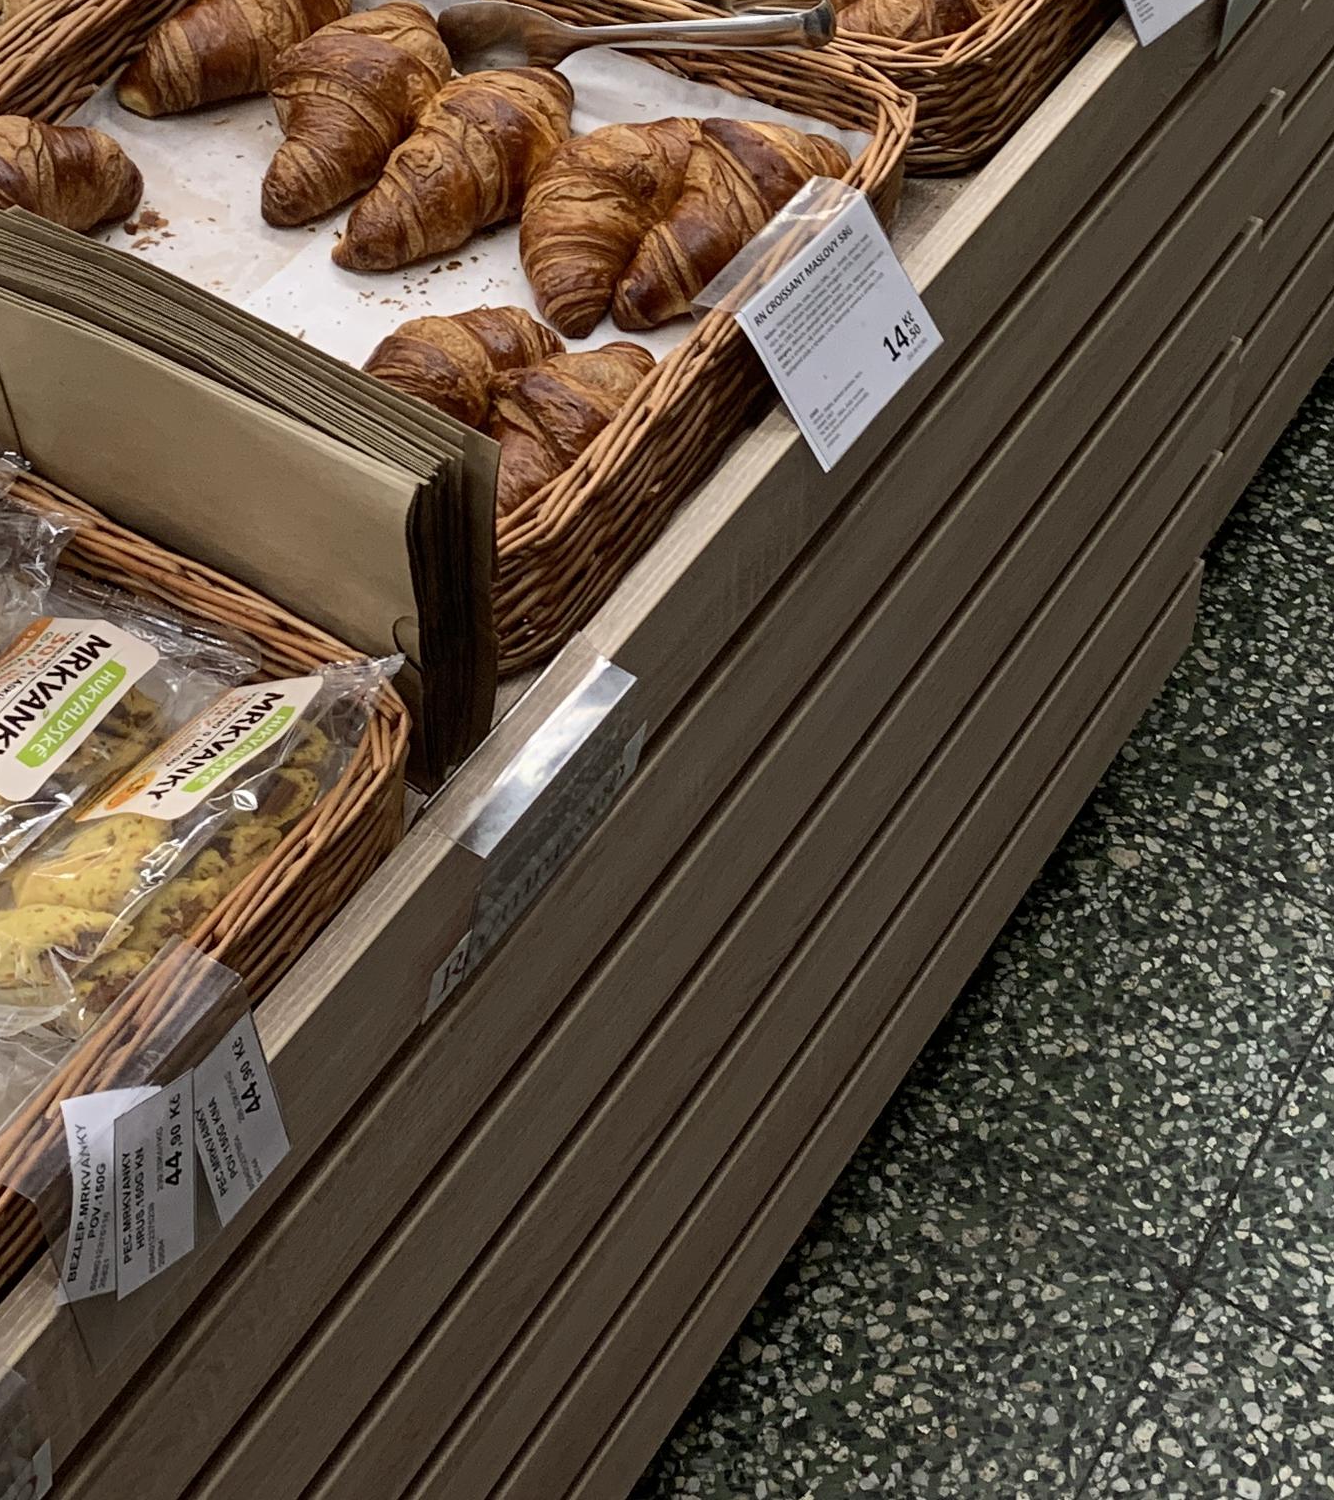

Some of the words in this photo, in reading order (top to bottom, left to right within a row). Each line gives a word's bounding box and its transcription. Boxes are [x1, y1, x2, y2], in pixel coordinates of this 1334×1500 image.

[754, 313, 767, 327] RN
[766, 272, 806, 315] CROISSANT
[805, 240, 841, 279] MASLOVY
[27, 666, 116, 760] HUKVALDSKÉ
[169, 1092, 181, 1120] Kč
[122, 1152, 131, 1264] PEC.MRKVANKY
